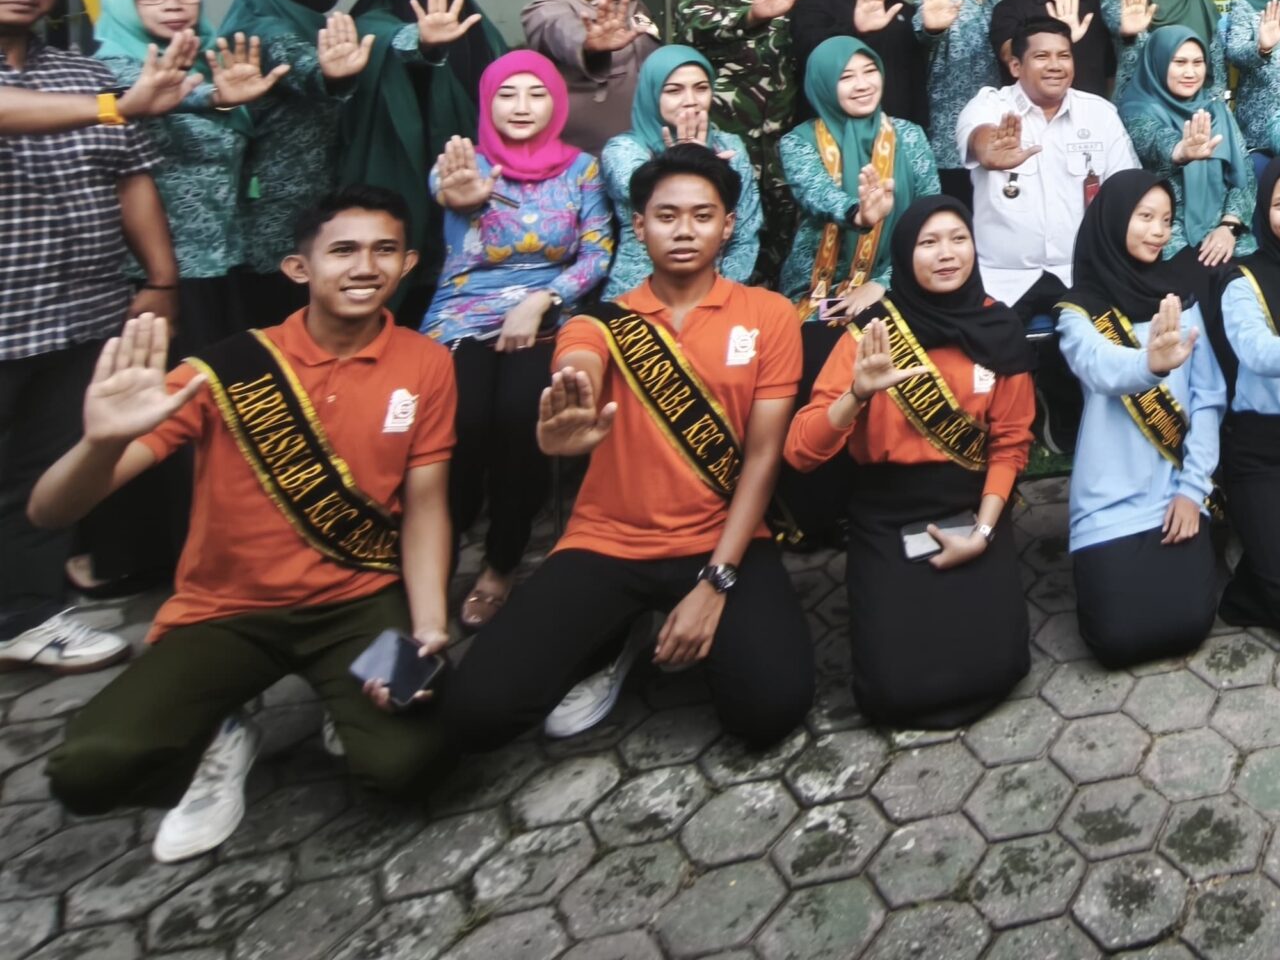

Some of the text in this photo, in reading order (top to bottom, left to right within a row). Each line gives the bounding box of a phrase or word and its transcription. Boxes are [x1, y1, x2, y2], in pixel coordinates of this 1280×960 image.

[610, 313, 696, 422] JARWASNABA
[228, 373, 329, 502] JARWASNABA
[304, 491, 358, 538] KEC.
